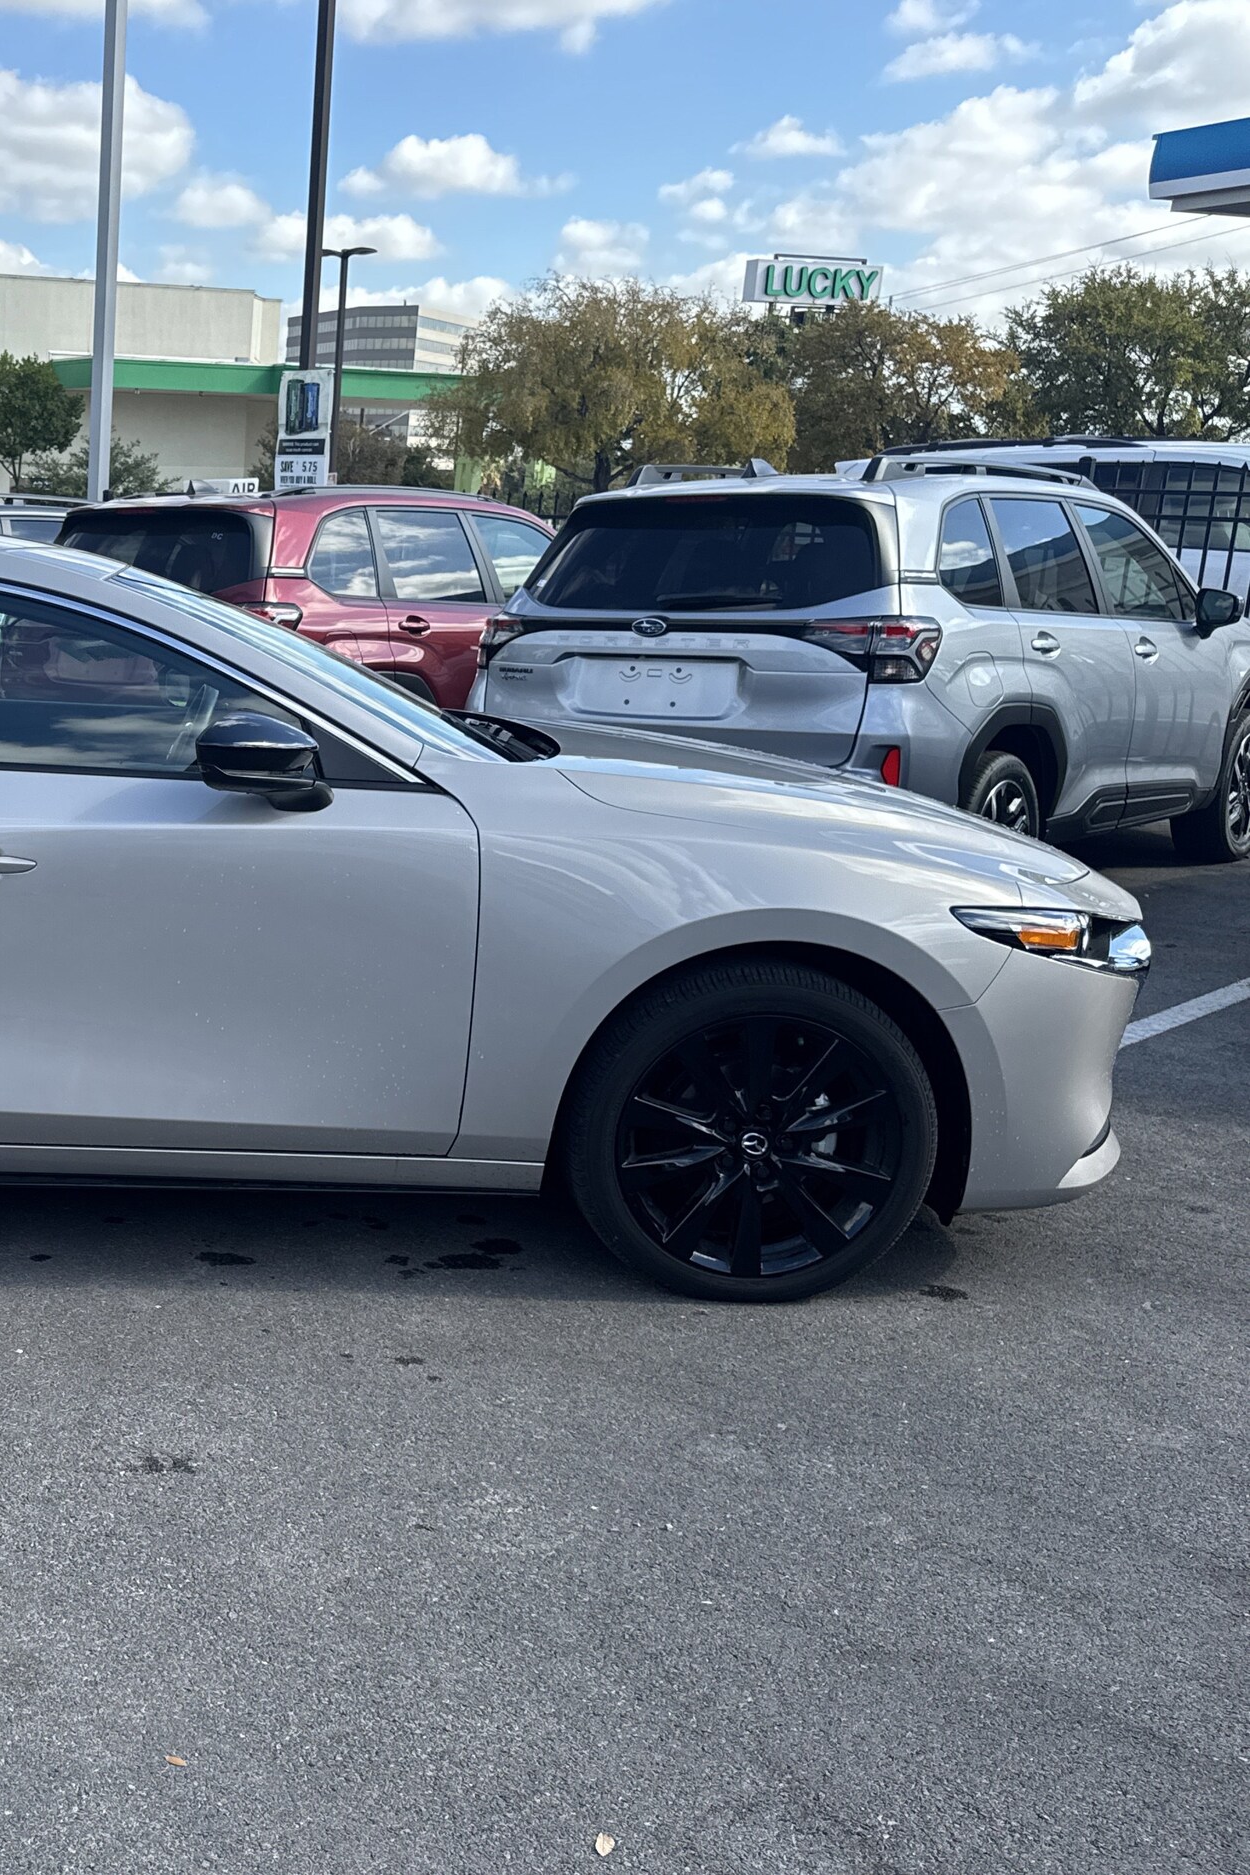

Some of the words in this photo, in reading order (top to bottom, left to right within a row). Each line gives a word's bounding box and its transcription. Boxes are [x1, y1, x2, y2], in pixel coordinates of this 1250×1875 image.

[765, 264, 879, 301] LUCKY
[280, 461, 294, 473] SAVE
[232, 482, 256, 493] AIR
[557, 634, 750, 649] FORESTER
